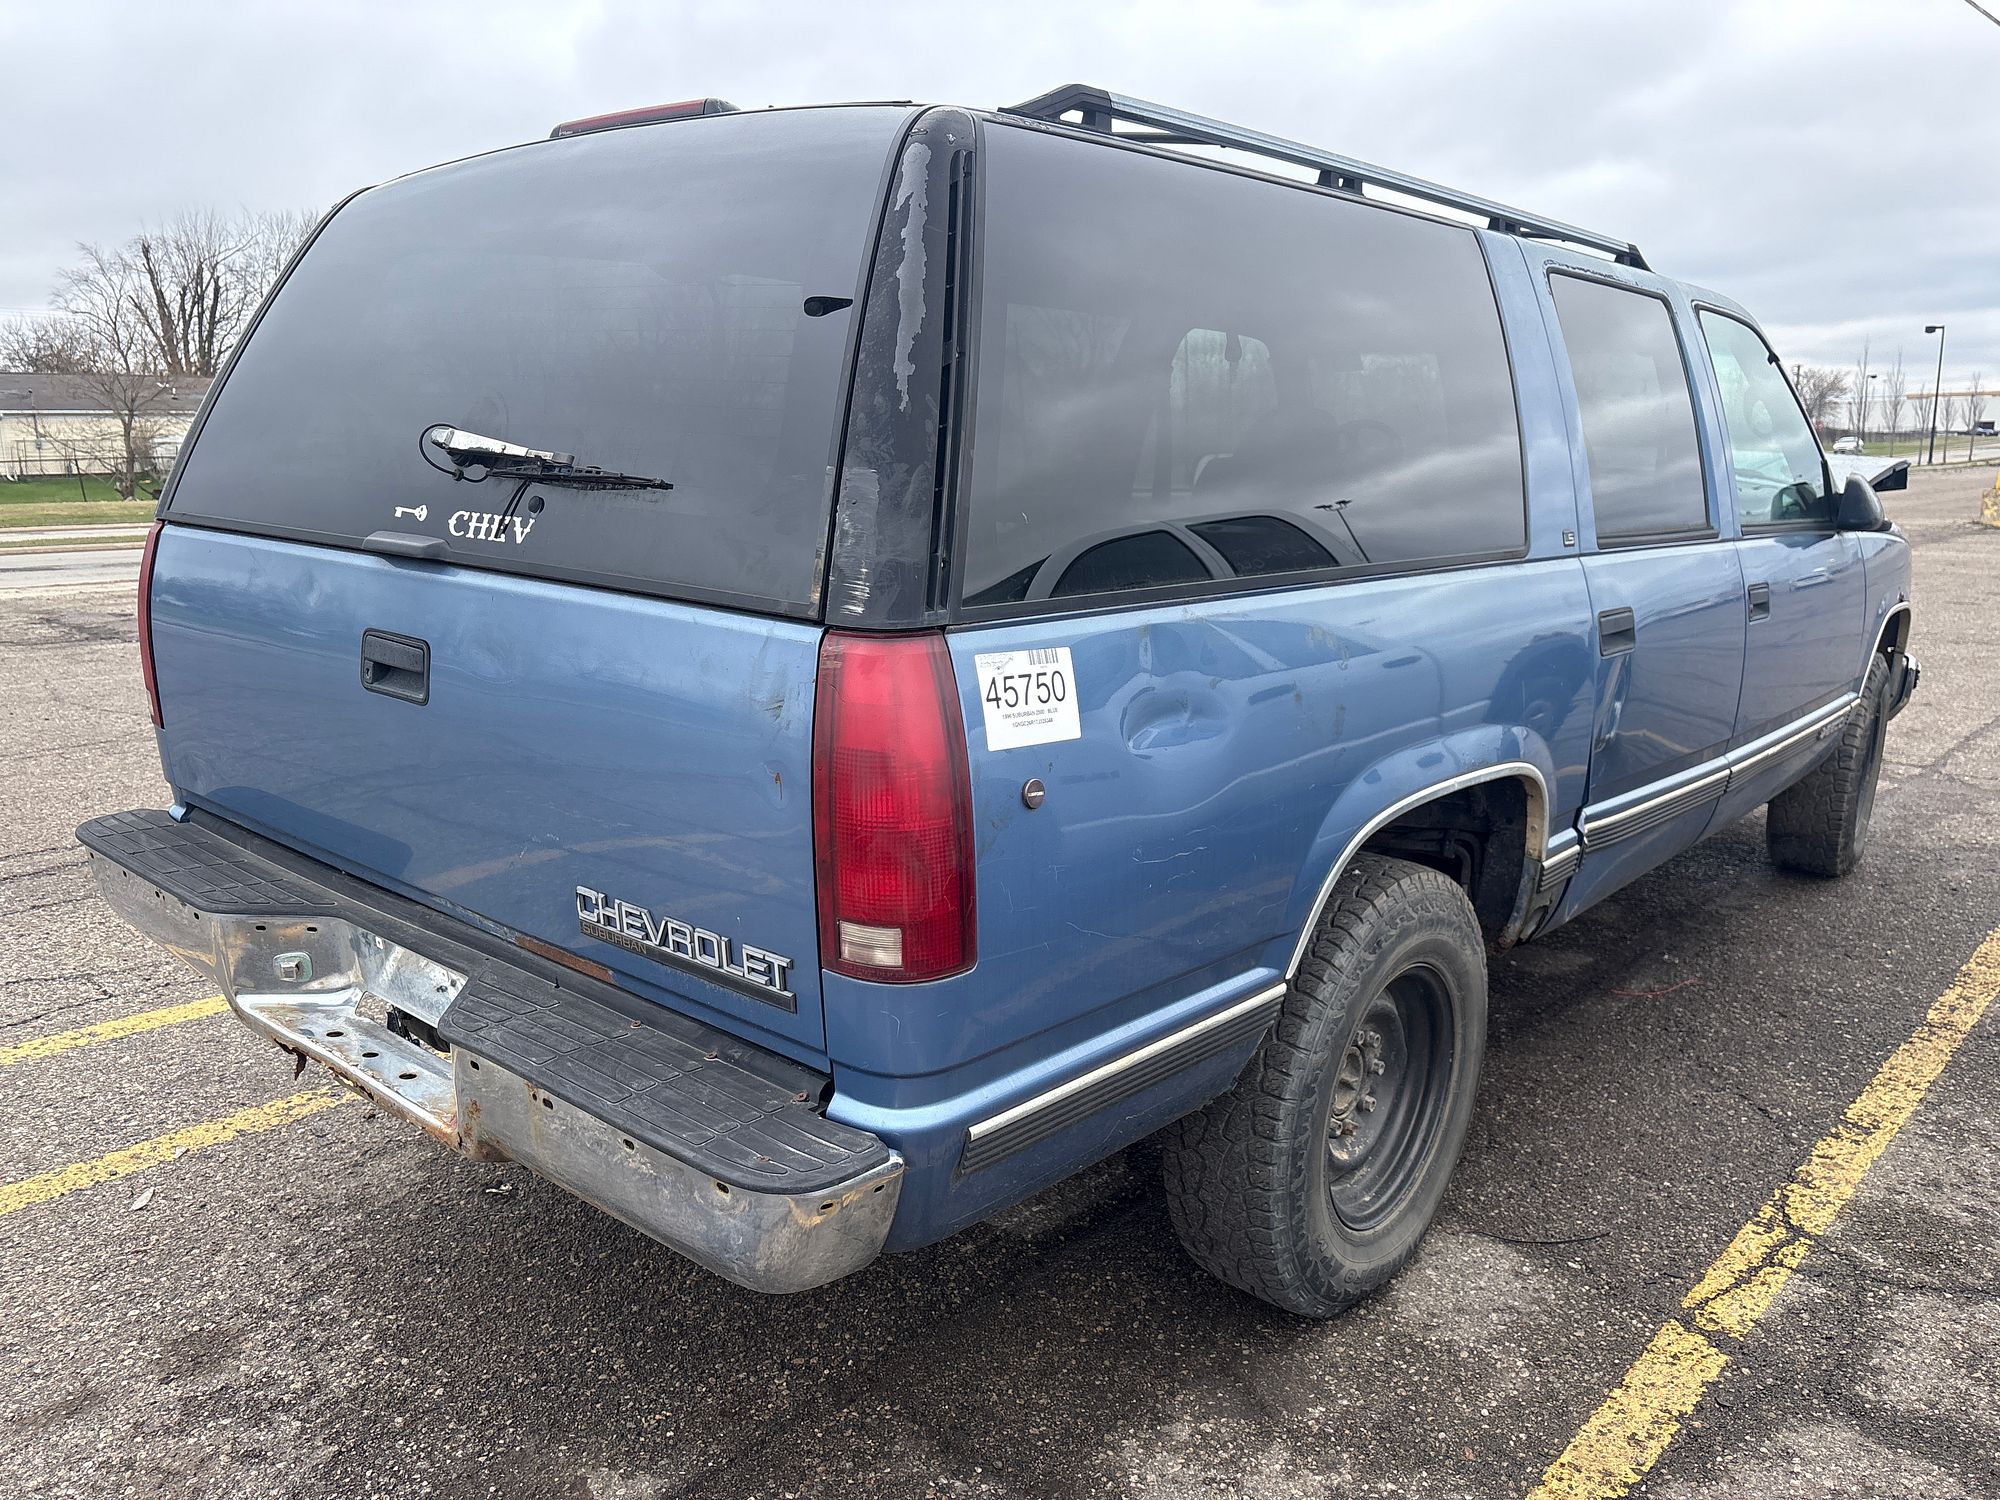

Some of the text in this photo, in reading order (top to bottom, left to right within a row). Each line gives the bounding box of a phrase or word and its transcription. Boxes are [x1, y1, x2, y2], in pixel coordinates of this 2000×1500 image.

[448, 510, 536, 544] CHEV
[986, 670, 1066, 709] 45750
[576, 885, 794, 992] CHEVROLET
[581, 921, 647, 955] SUBURBAN
